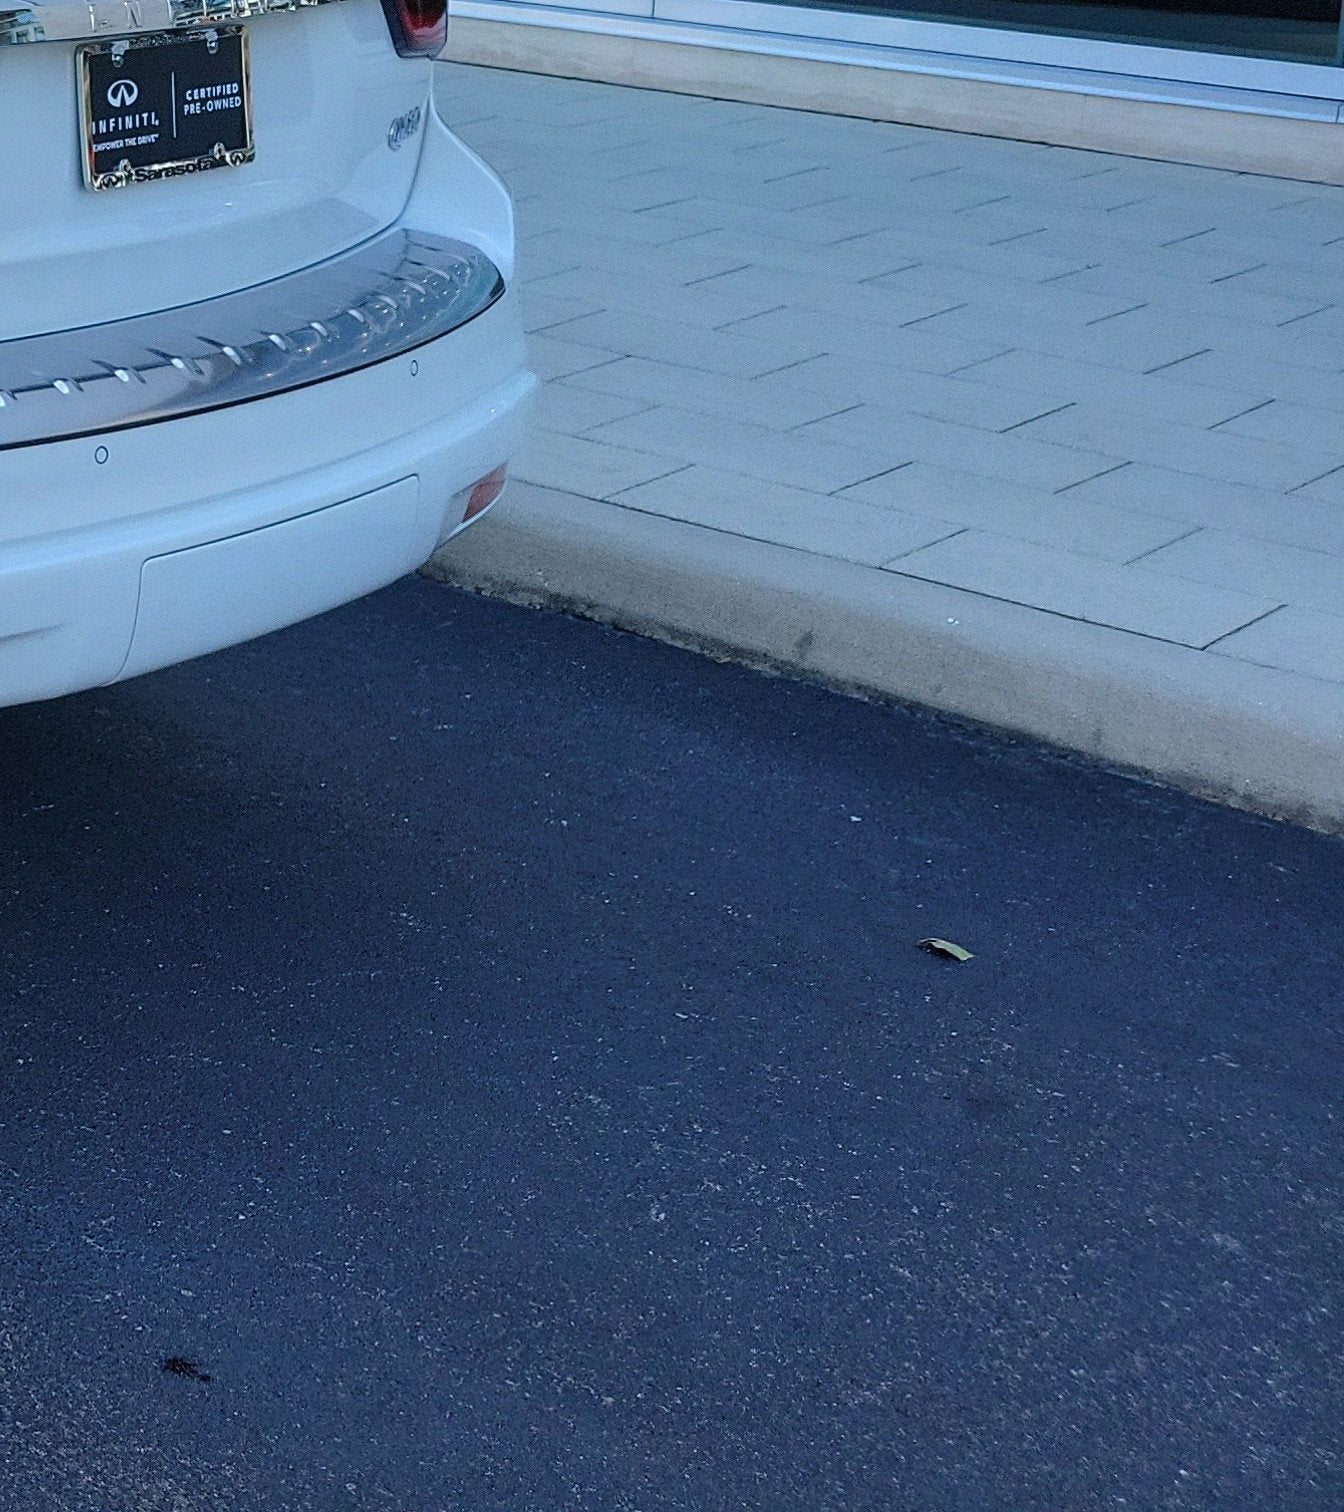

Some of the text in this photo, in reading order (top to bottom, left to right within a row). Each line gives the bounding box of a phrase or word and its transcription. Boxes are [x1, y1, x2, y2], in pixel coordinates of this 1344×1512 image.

[185, 82, 239, 101] CERTIFIED
[183, 95, 242, 116] PRE-OWNED
[92, 111, 156, 135] INFINITI
[134, 157, 214, 183] Sarasota
